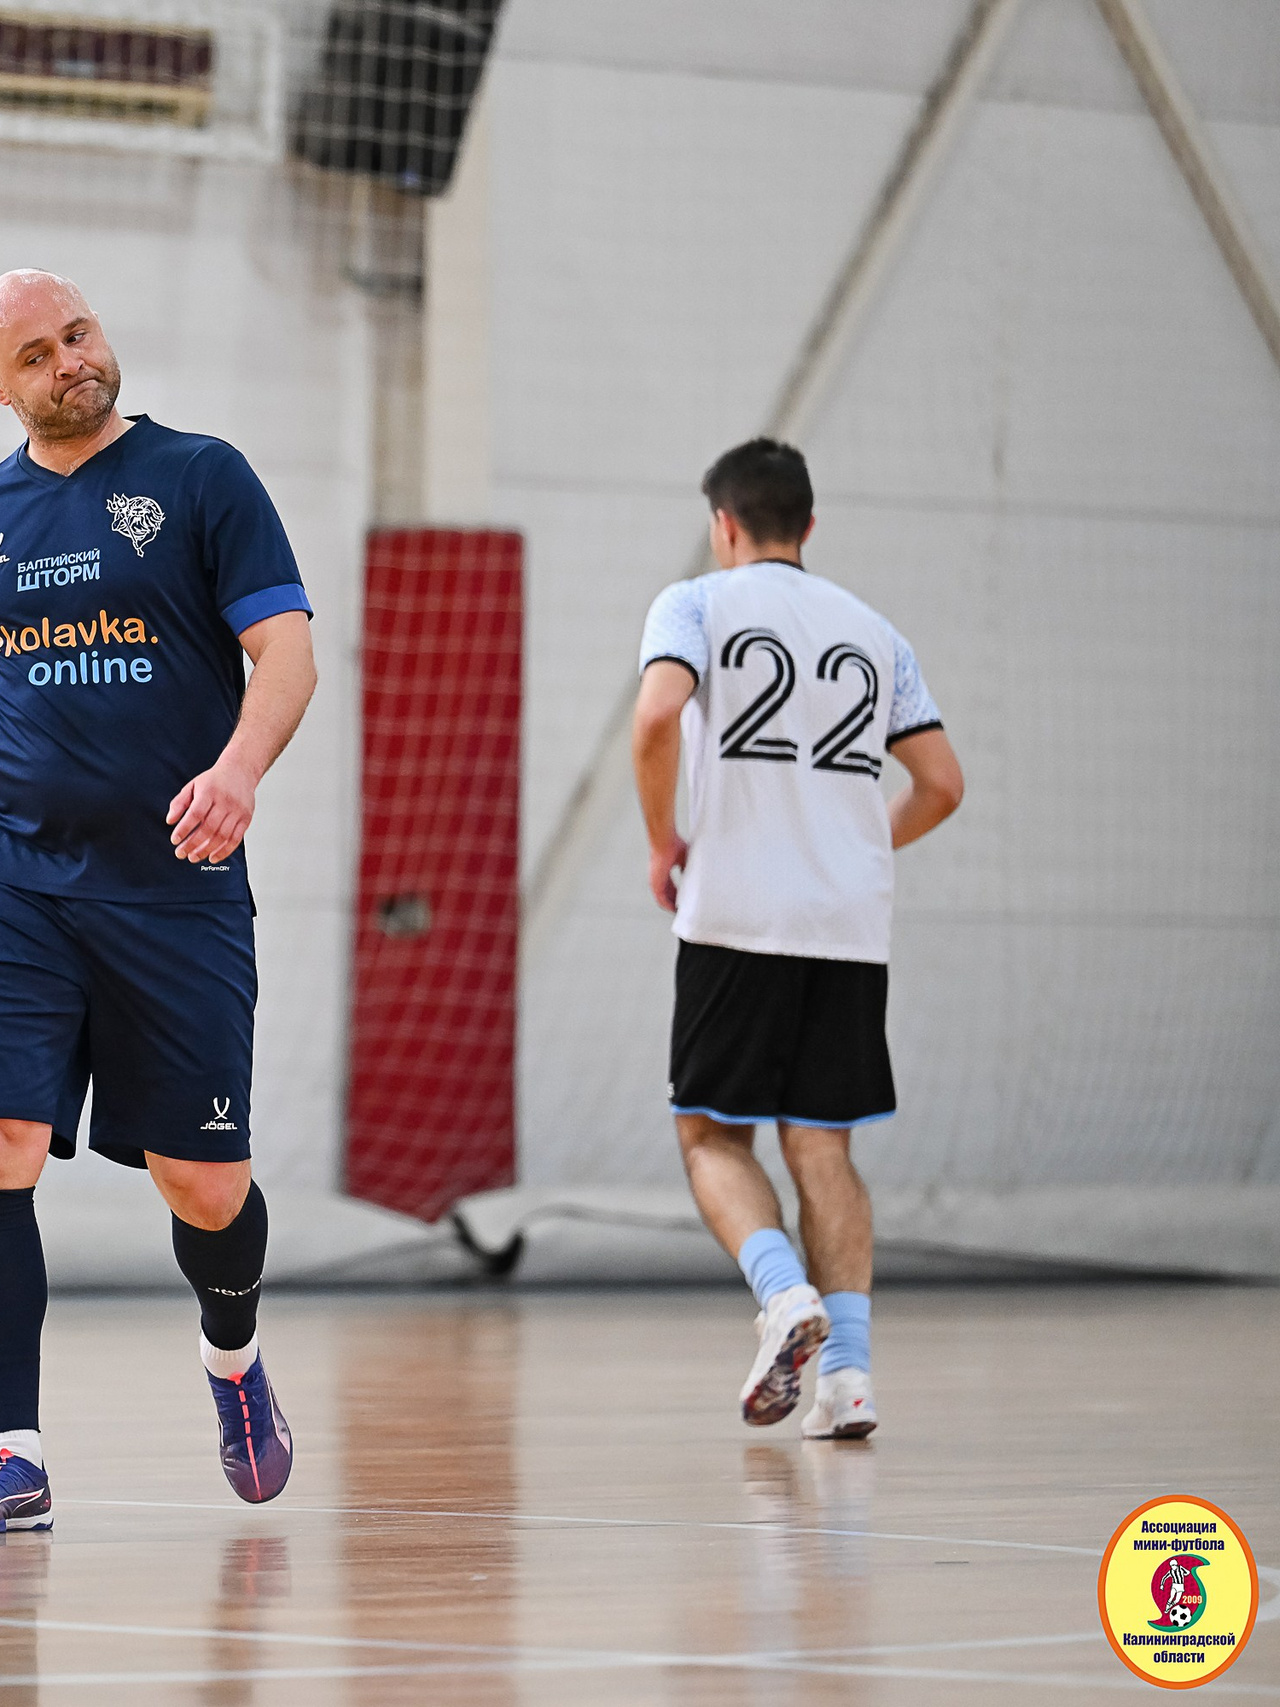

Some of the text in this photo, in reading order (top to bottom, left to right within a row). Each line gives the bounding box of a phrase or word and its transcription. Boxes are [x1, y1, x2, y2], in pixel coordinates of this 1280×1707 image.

[17, 548, 100, 573] БАЛТИЙСКИЙ
[17, 562, 100, 592] ШТОРМ
[28, 651, 153, 686] online
[719, 627, 882, 782] 22
[200, 1120, 238, 1130] JÖGEL
